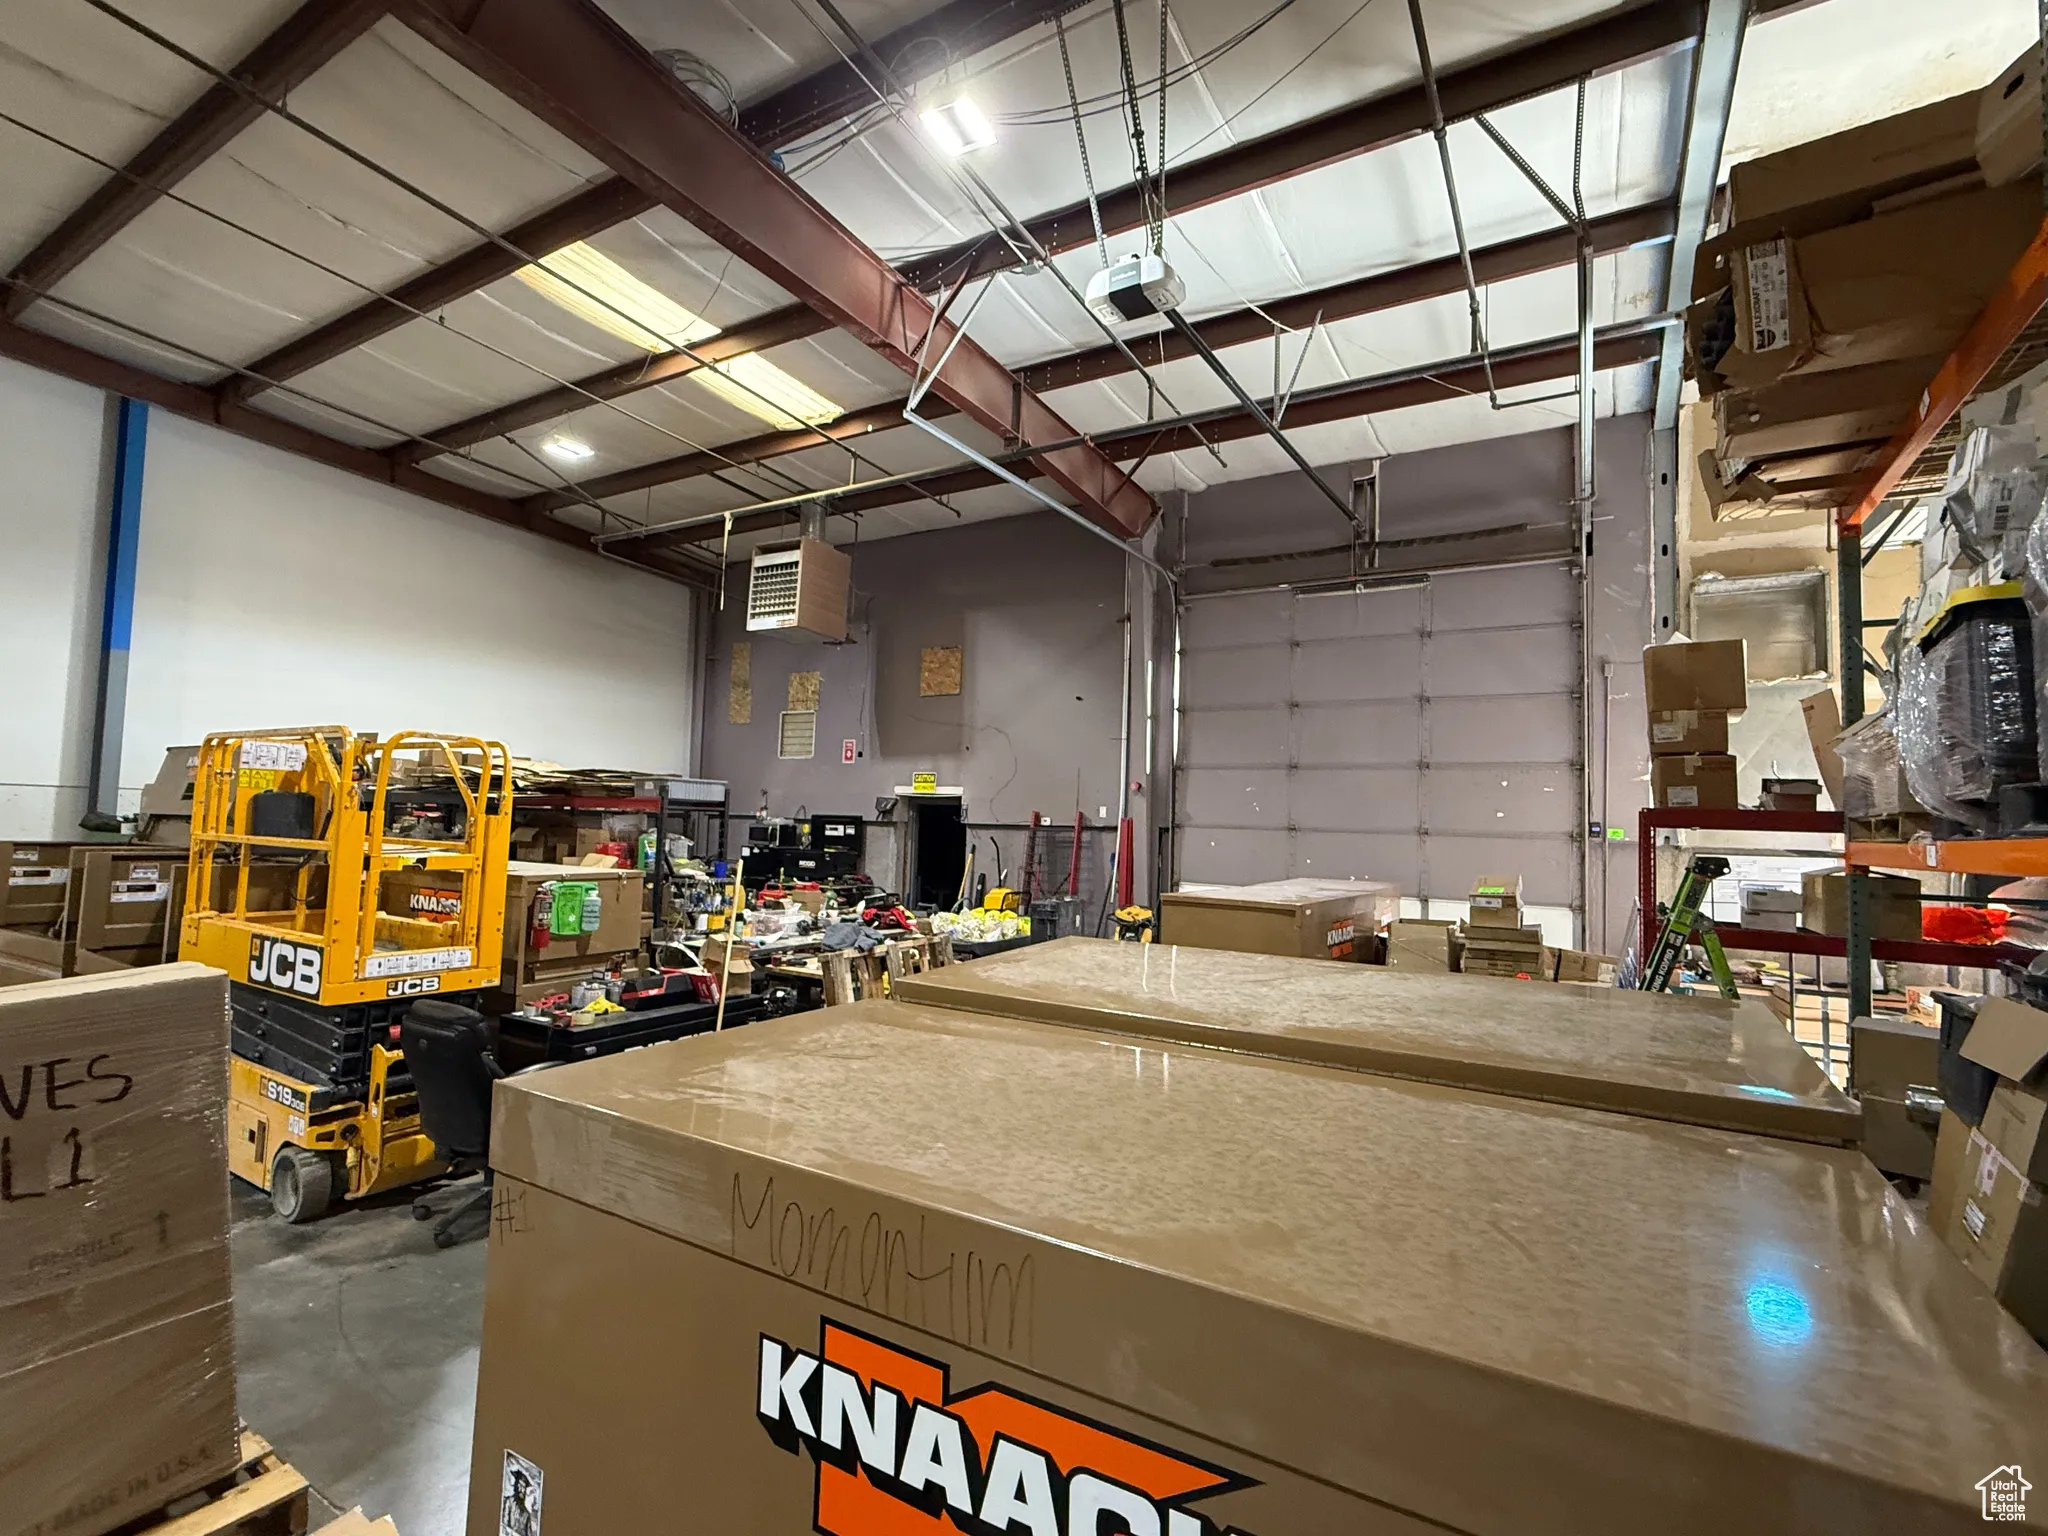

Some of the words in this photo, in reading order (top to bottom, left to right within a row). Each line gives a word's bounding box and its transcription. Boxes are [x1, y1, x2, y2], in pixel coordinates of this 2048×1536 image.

[250, 939, 321, 996] JCB
[388, 976, 440, 997] JCB
[757, 1335, 1244, 1536] KNAAC
